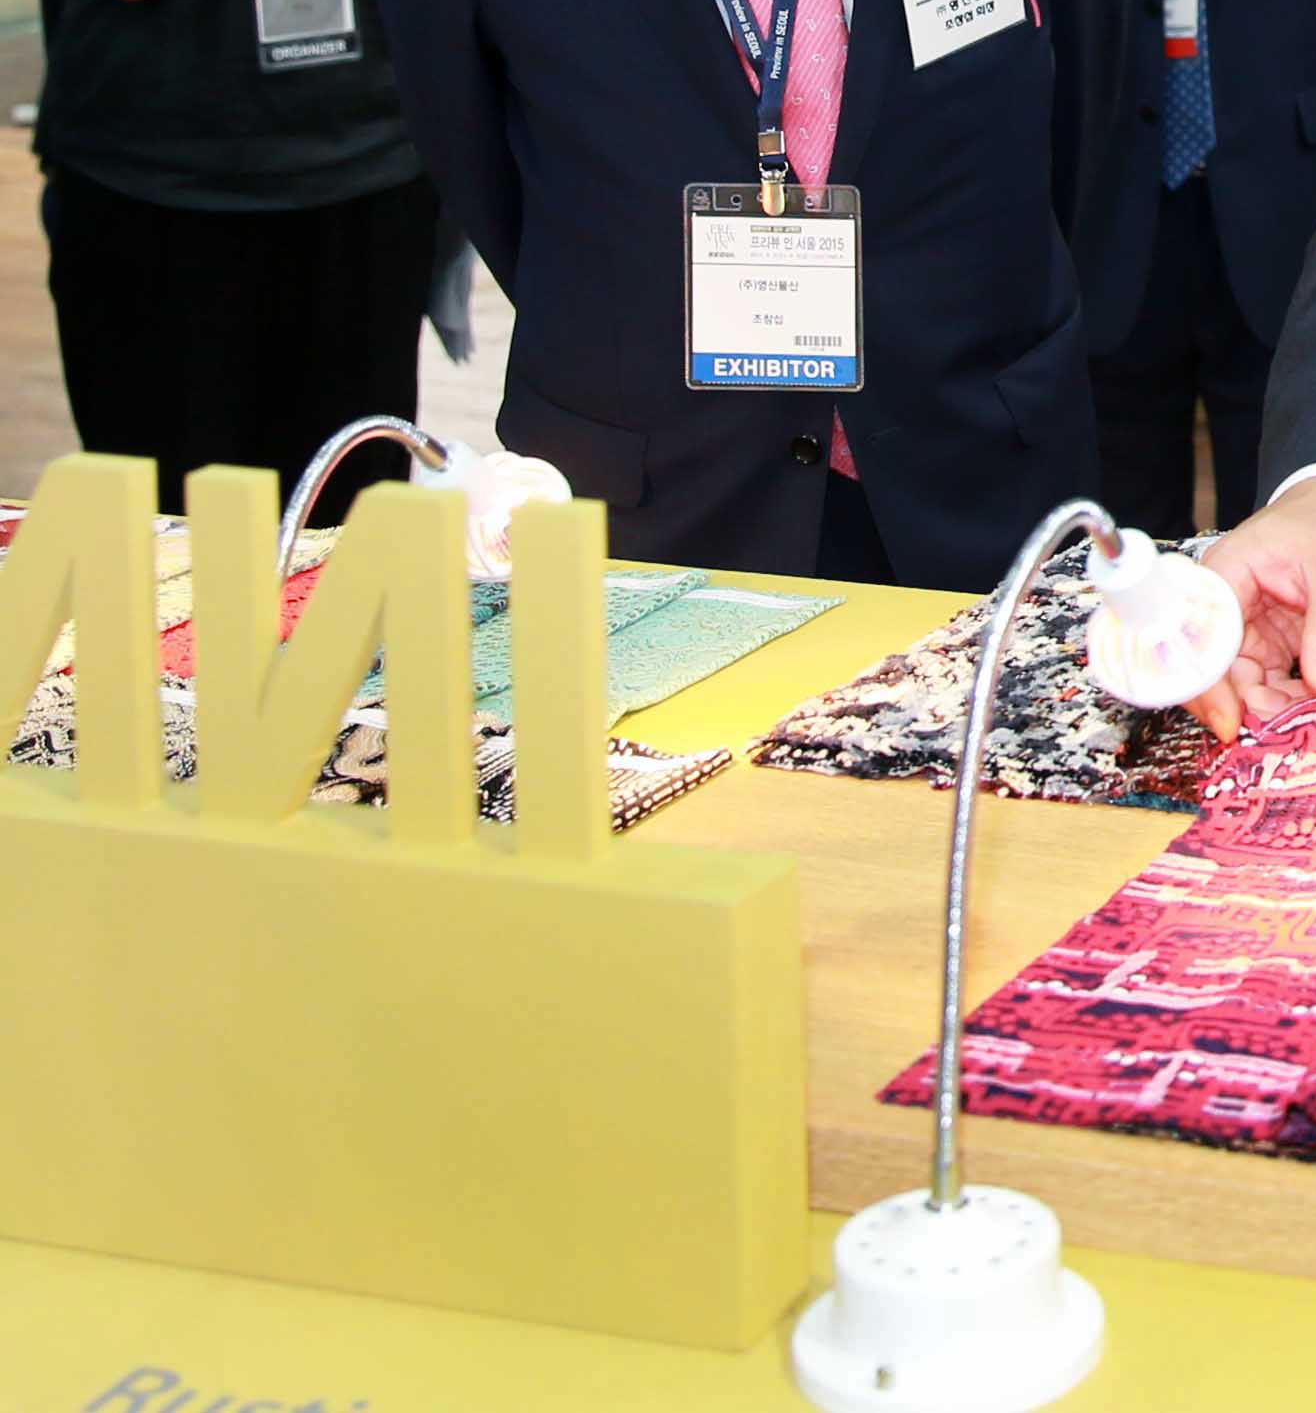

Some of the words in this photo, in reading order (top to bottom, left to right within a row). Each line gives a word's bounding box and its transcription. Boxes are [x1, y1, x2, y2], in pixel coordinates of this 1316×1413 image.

[774, 8, 789, 38] SEOUL
[743, 30, 762, 60] SEOUL
[769, 44, 784, 80] Preview
[818, 237, 846, 252] 2015
[713, 357, 836, 379] EXHIBITOR
